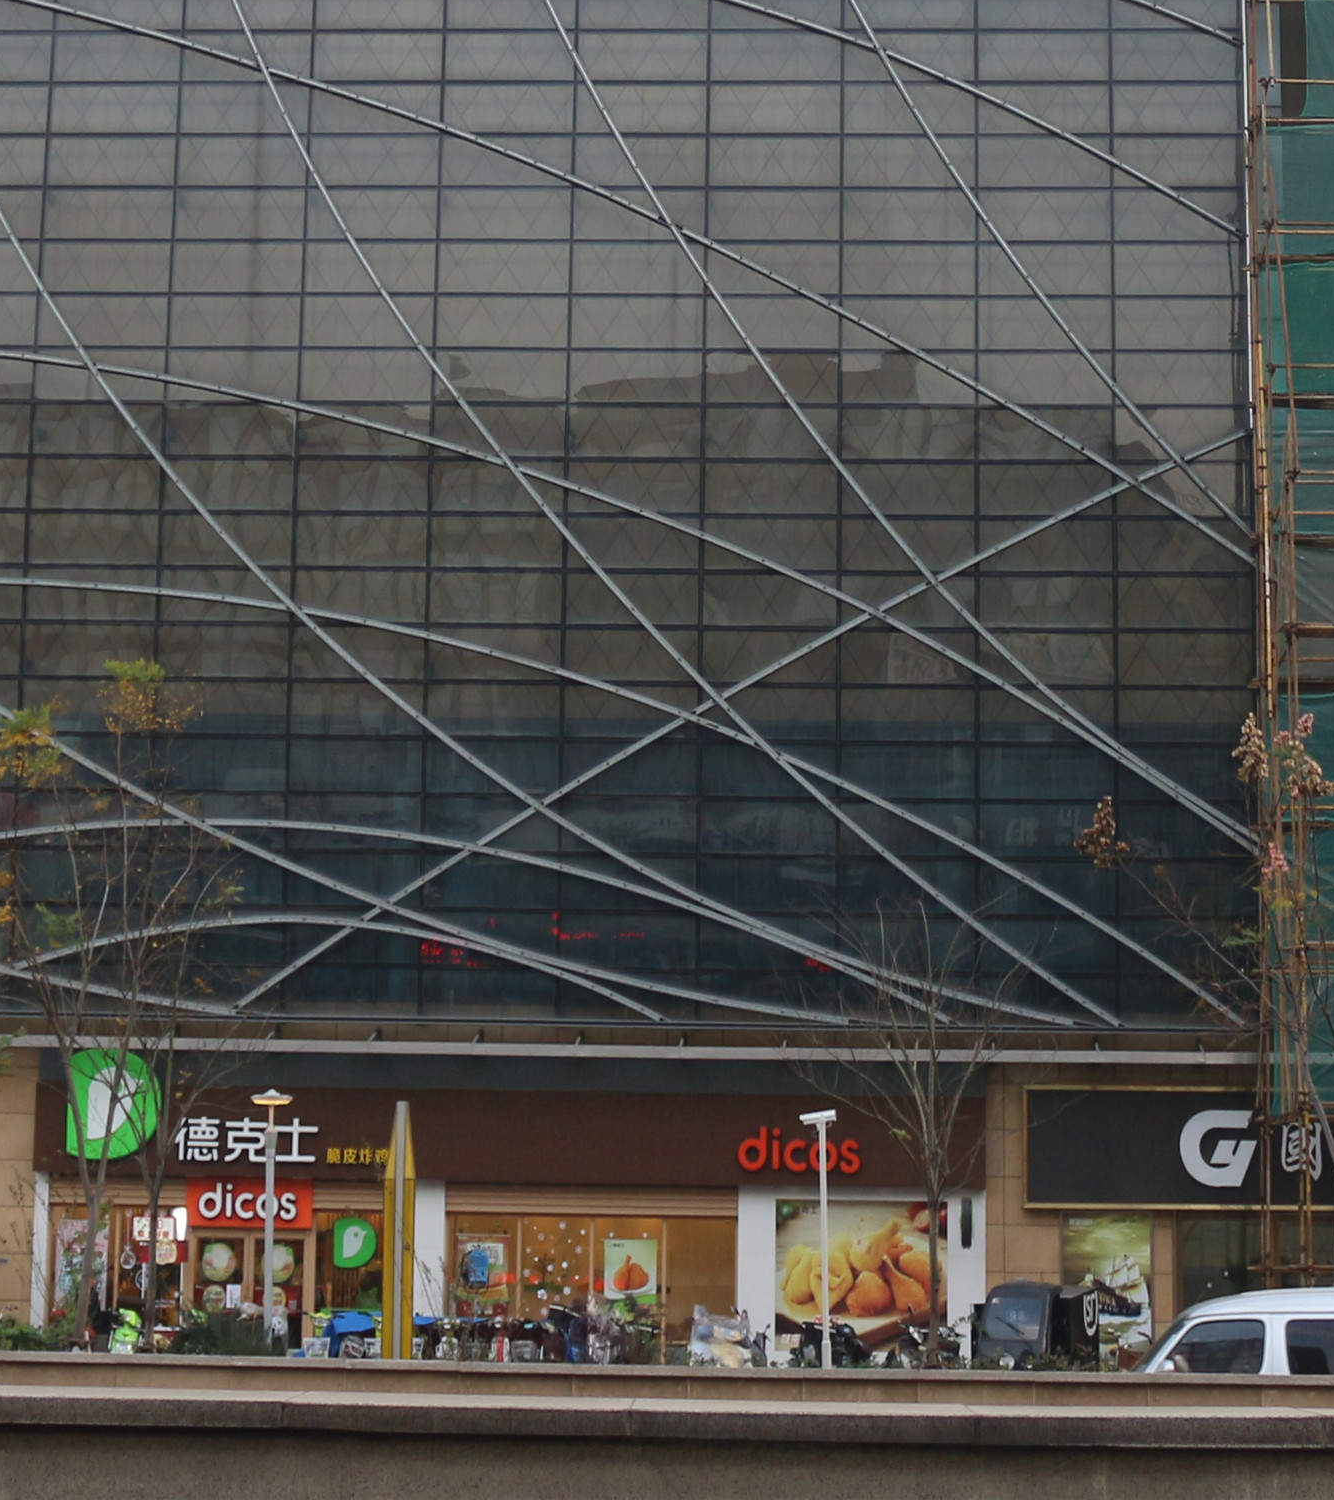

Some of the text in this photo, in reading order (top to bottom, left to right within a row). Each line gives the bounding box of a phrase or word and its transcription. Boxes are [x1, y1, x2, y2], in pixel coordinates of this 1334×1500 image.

[174, 1116, 319, 1163] 德克士
[738, 1126, 861, 1174] dicos
[198, 1182, 298, 1222] dicos
